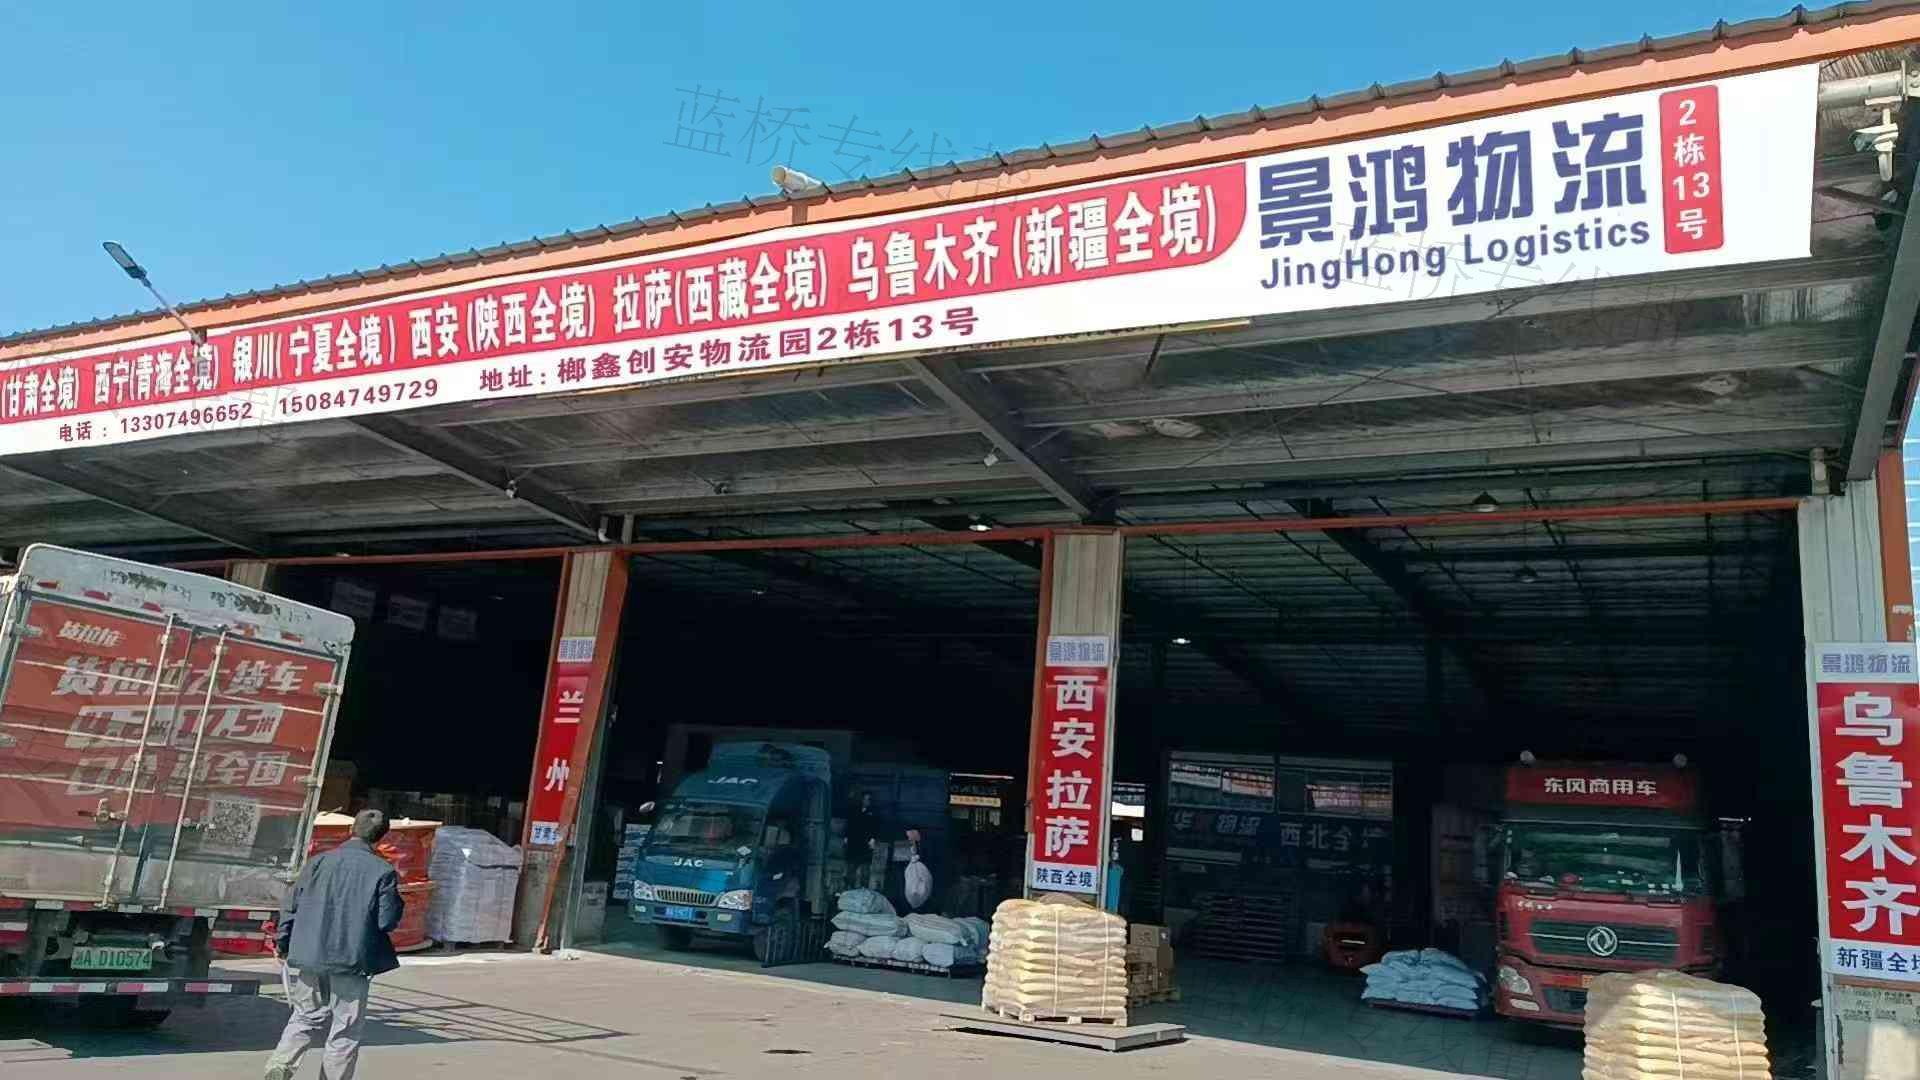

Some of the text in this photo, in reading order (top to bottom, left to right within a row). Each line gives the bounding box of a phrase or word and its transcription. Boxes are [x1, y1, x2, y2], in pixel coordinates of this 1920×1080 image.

[1258, 112, 1648, 249] 景鸿物流
[1260, 218, 1651, 292] JingHong Logistics
[121, 402, 253, 434] 13307496652
[279, 378, 438, 415] 15084749729
[1822, 653, 1912, 674] 景鸿物流
[544, 690, 584, 792] 兰州
[1044, 675, 1098, 858] 西安拉萨
[707, 775, 759, 785] JAC
[1544, 776, 1657, 796] 东风商用车
[1835, 691, 1920, 937] 乌鲁木齐
[673, 857, 705, 868] JAC
[1036, 867, 1093, 888] 陕西全境
